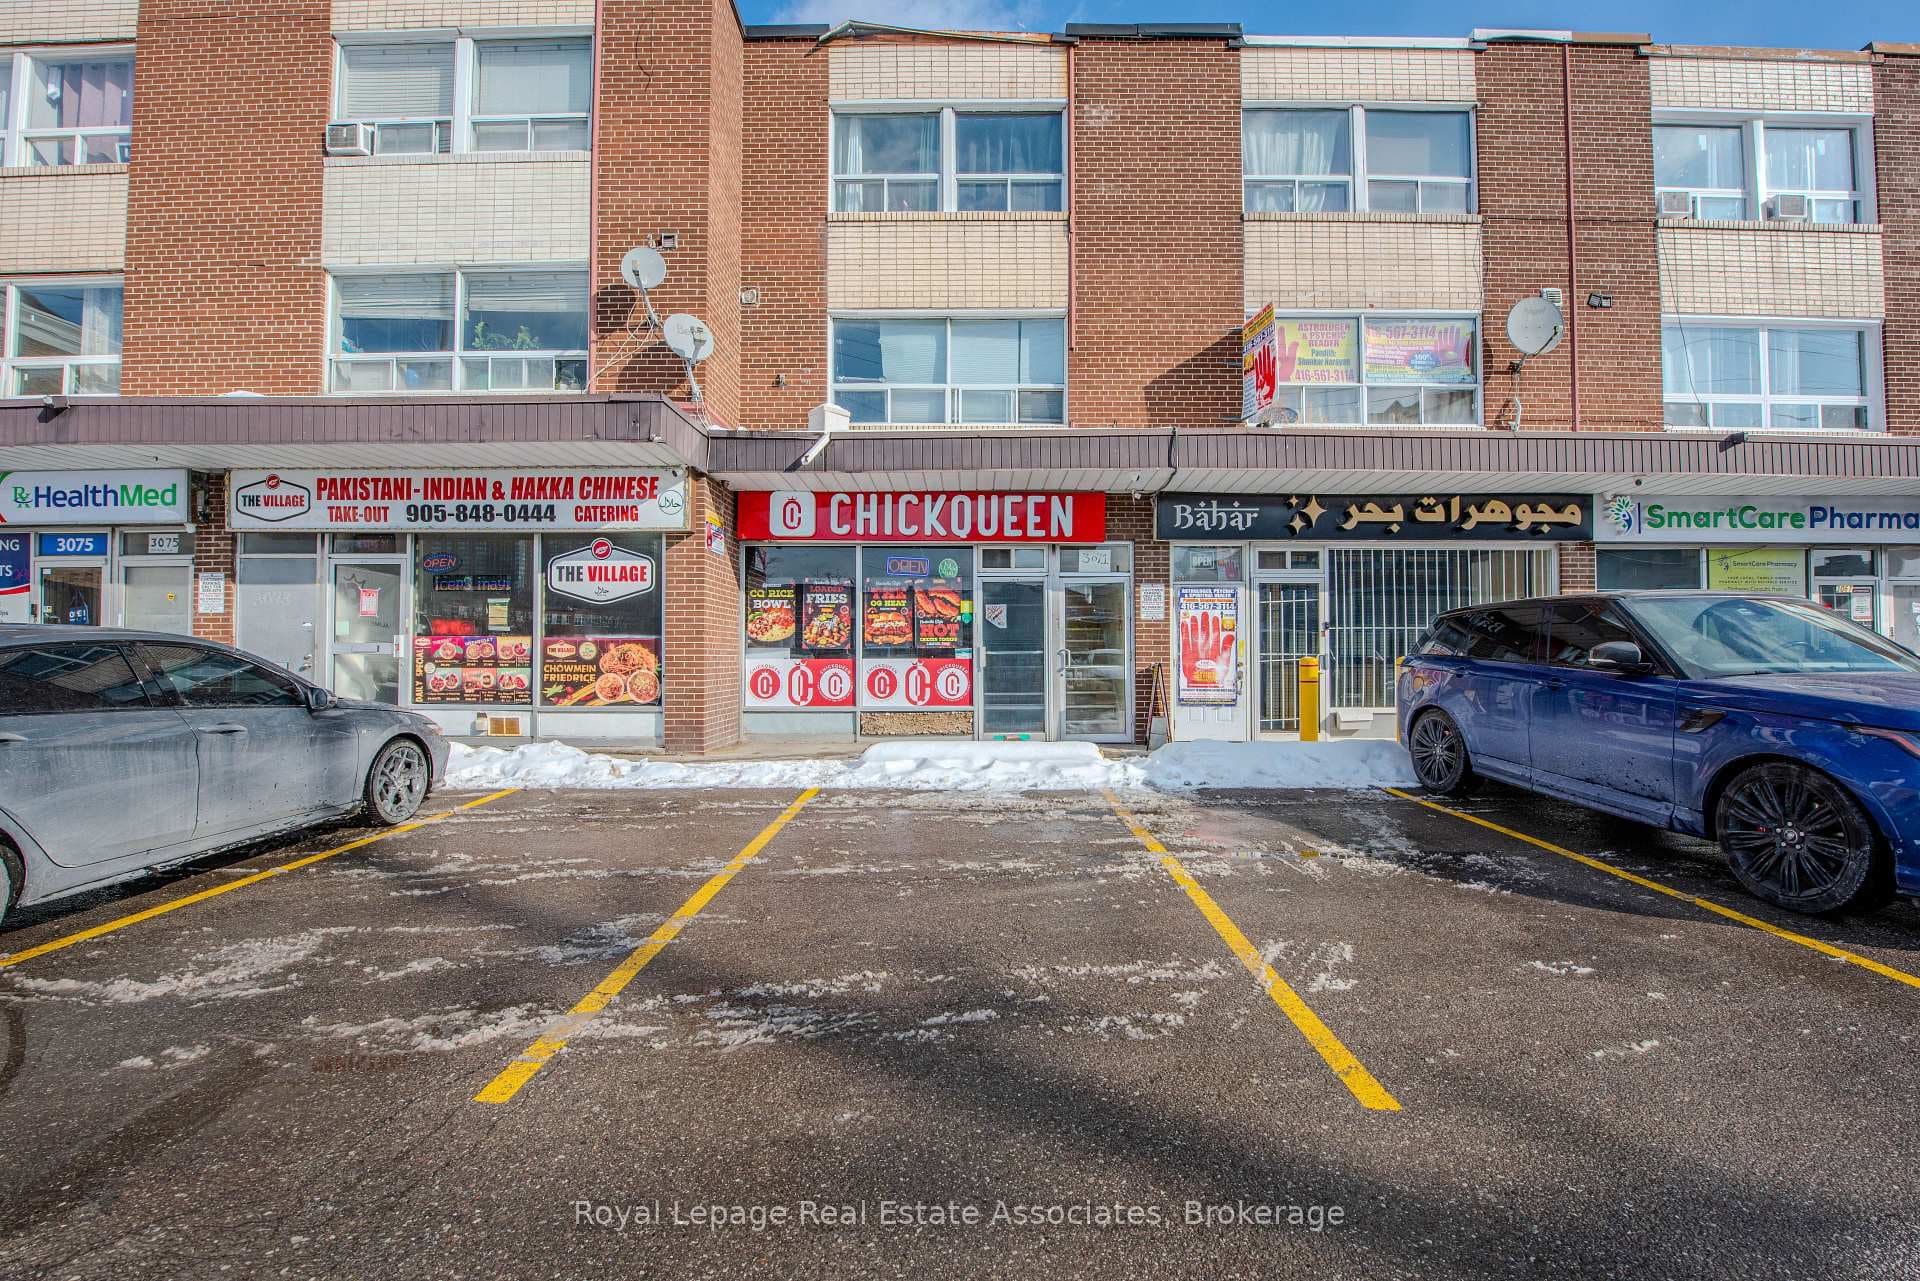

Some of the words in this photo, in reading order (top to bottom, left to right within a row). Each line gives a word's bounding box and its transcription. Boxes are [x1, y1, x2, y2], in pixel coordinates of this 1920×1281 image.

[492, 480, 505, 500] &
[510, 477, 574, 500] HAKKA
[579, 476, 660, 500] CHINESE
[34, 483, 177, 508] HealthMed
[241, 495, 261, 507] THE
[263, 495, 305, 507] VILLAGE
[327, 506, 389, 523] TAKE-OUT
[406, 503, 556, 523] 905-848-0444
[574, 505, 639, 522] CATERING
[829, 493, 1073, 539] CHICKQUEEN
[1341, 502, 1404, 533] بحر
[1414, 496, 1582, 534] مجوهرات
[1647, 504, 1806, 529] SmartCare
[56, 538, 94, 552] 3075
[151, 537, 179, 548] 3075
[423, 557, 457, 568] OPEN
[890, 559, 928, 574] OPEN
[556, 565, 584, 582] THE
[587, 565, 647, 582] VILLAGE
[768, 589, 794, 598] RICE
[807, 593, 848, 604] FRIES
[753, 599, 792, 609] BOWL
[919, 624, 960, 637] HOT
[543, 664, 596, 673] CHOWMEIN
[543, 673, 596, 682] FRIEDRICE
[416, 681, 424, 702] DAILY
